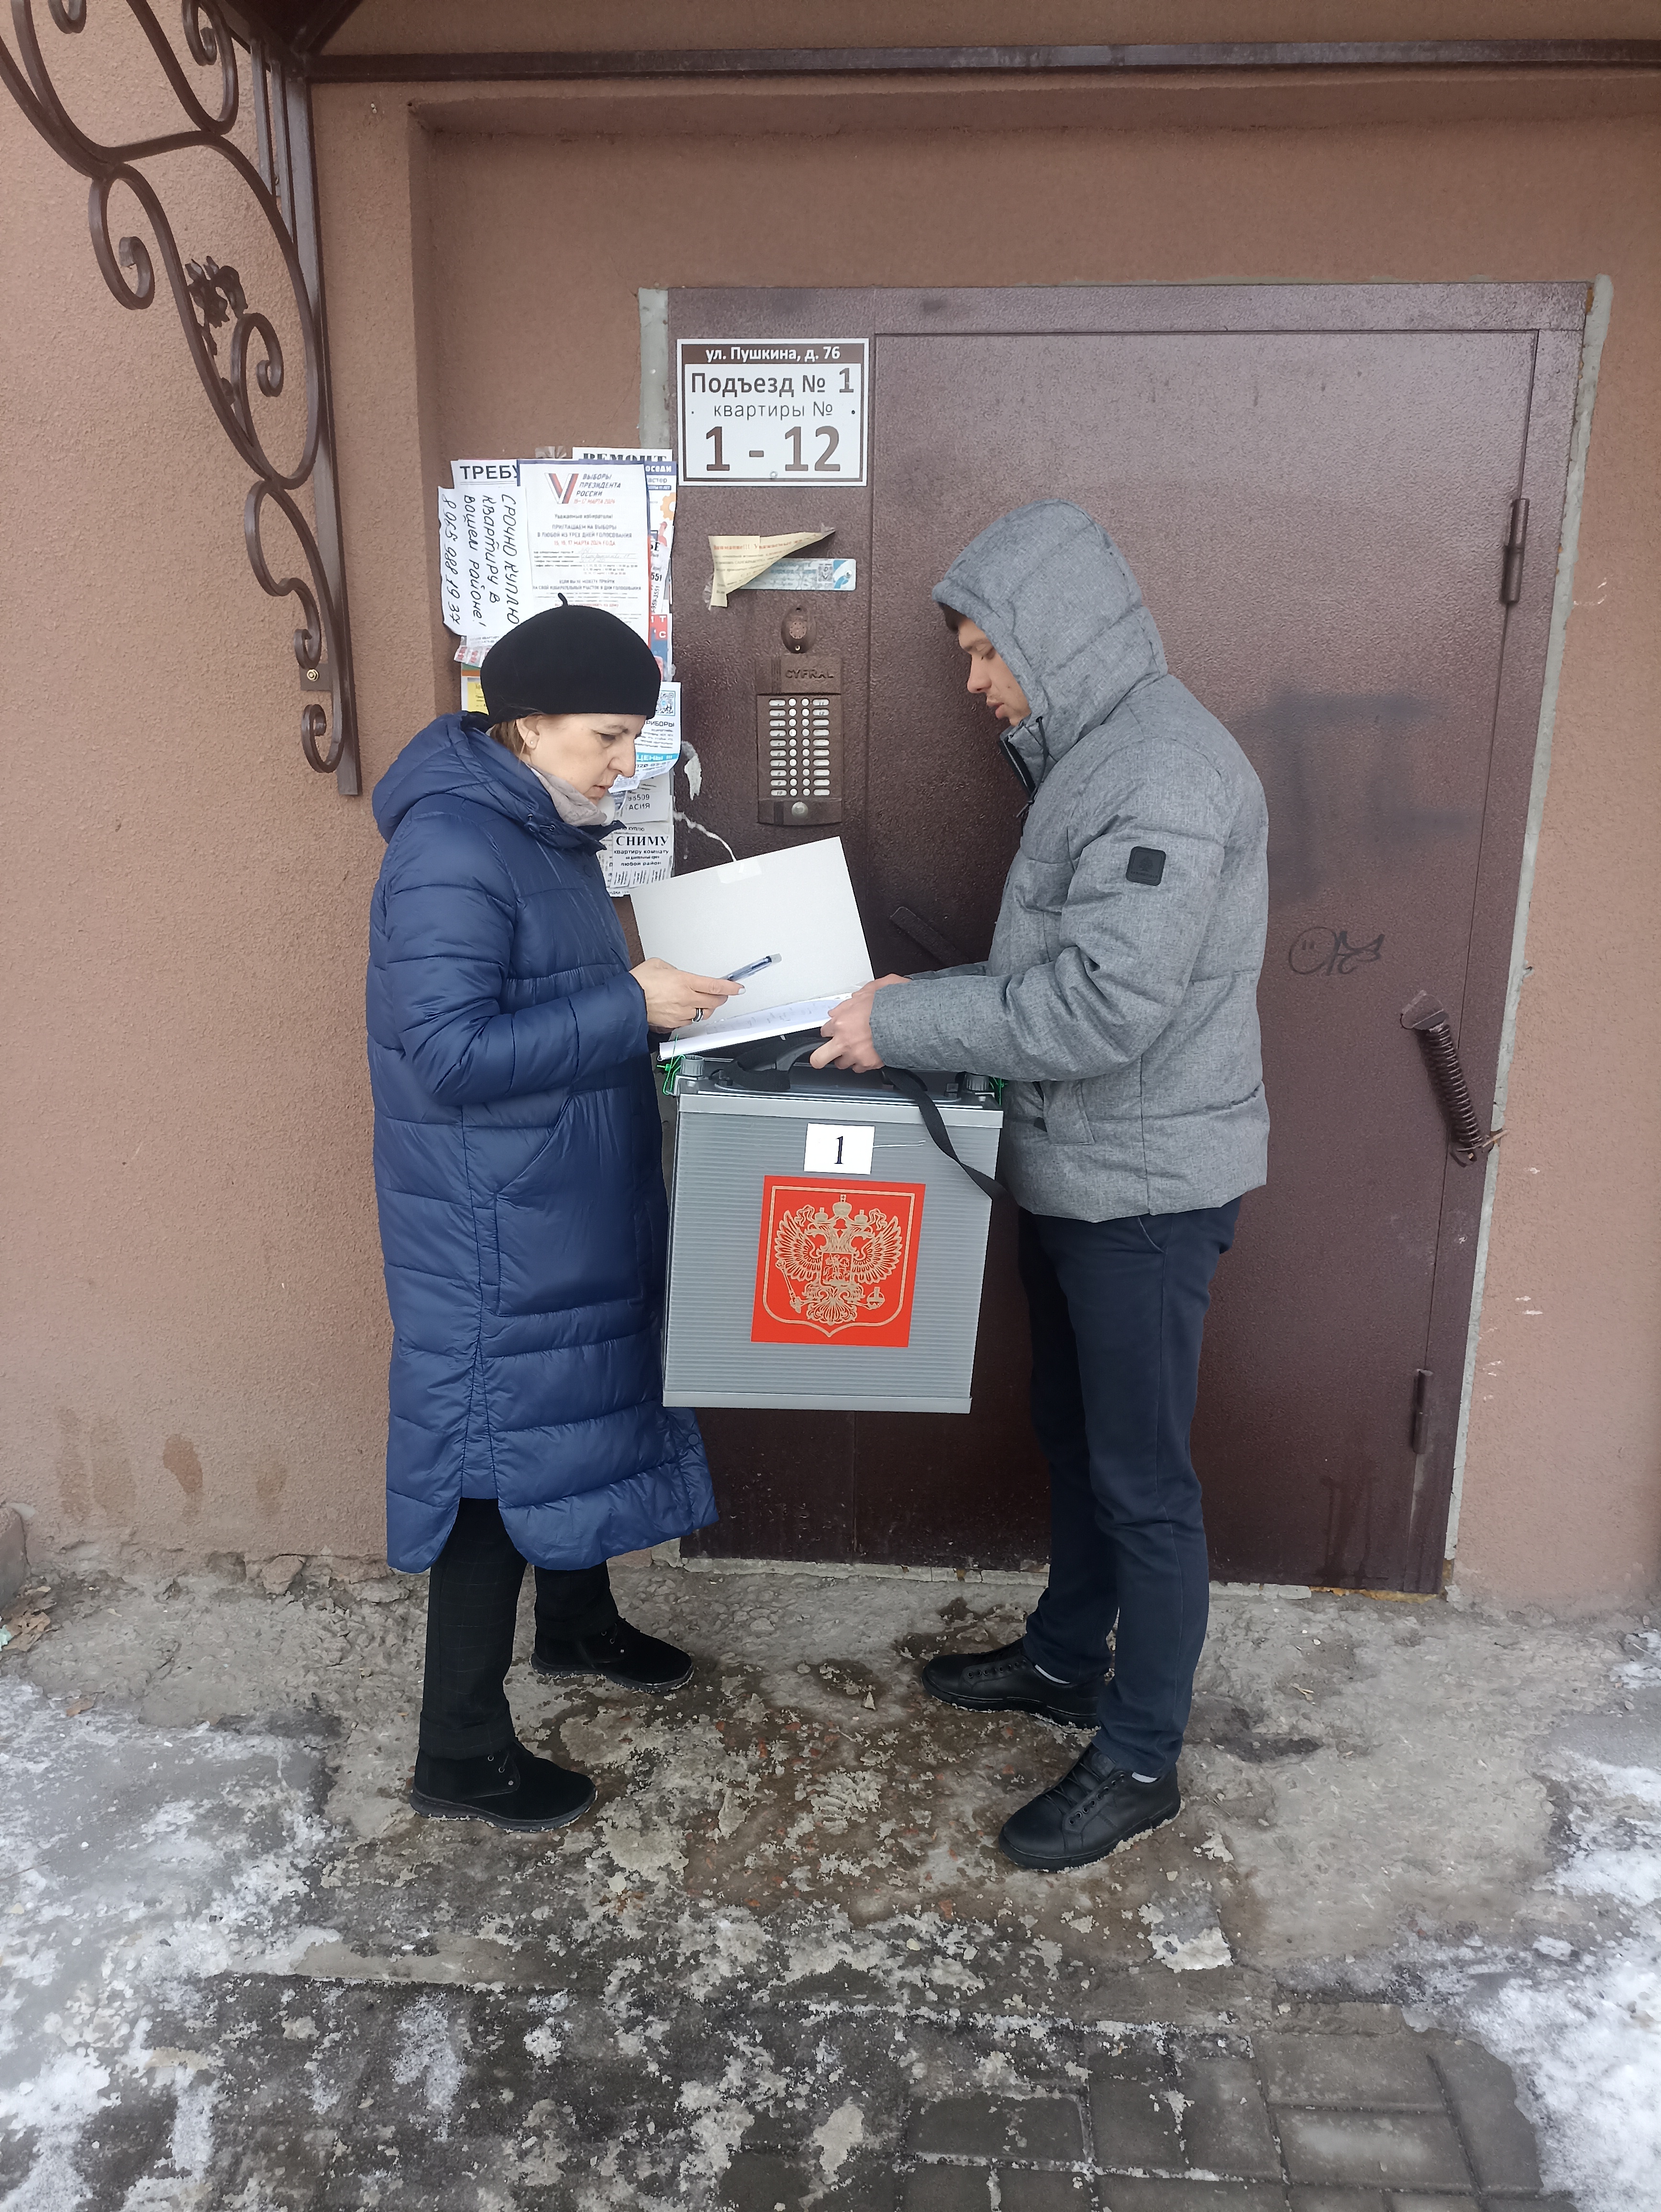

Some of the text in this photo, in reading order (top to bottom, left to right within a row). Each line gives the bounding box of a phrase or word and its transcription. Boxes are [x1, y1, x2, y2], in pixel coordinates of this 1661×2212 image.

[706, 346, 841, 363] ул. Пушкина, д. 76
[692, 368, 854, 398] Подъезд № 1
[714, 401, 833, 420] квартиры №
[706, 426, 730, 471] 1
[785, 426, 841, 471] 12
[460, 465, 517, 479] ТРЕБУ
[442, 494, 456, 509] 8
[501, 494, 520, 624] СРОЧНО КУПЛЮ
[785, 669, 834, 679] CYFRAL
[616, 836, 669, 846] СНИМУ
[834, 1136, 844, 1164] 1
